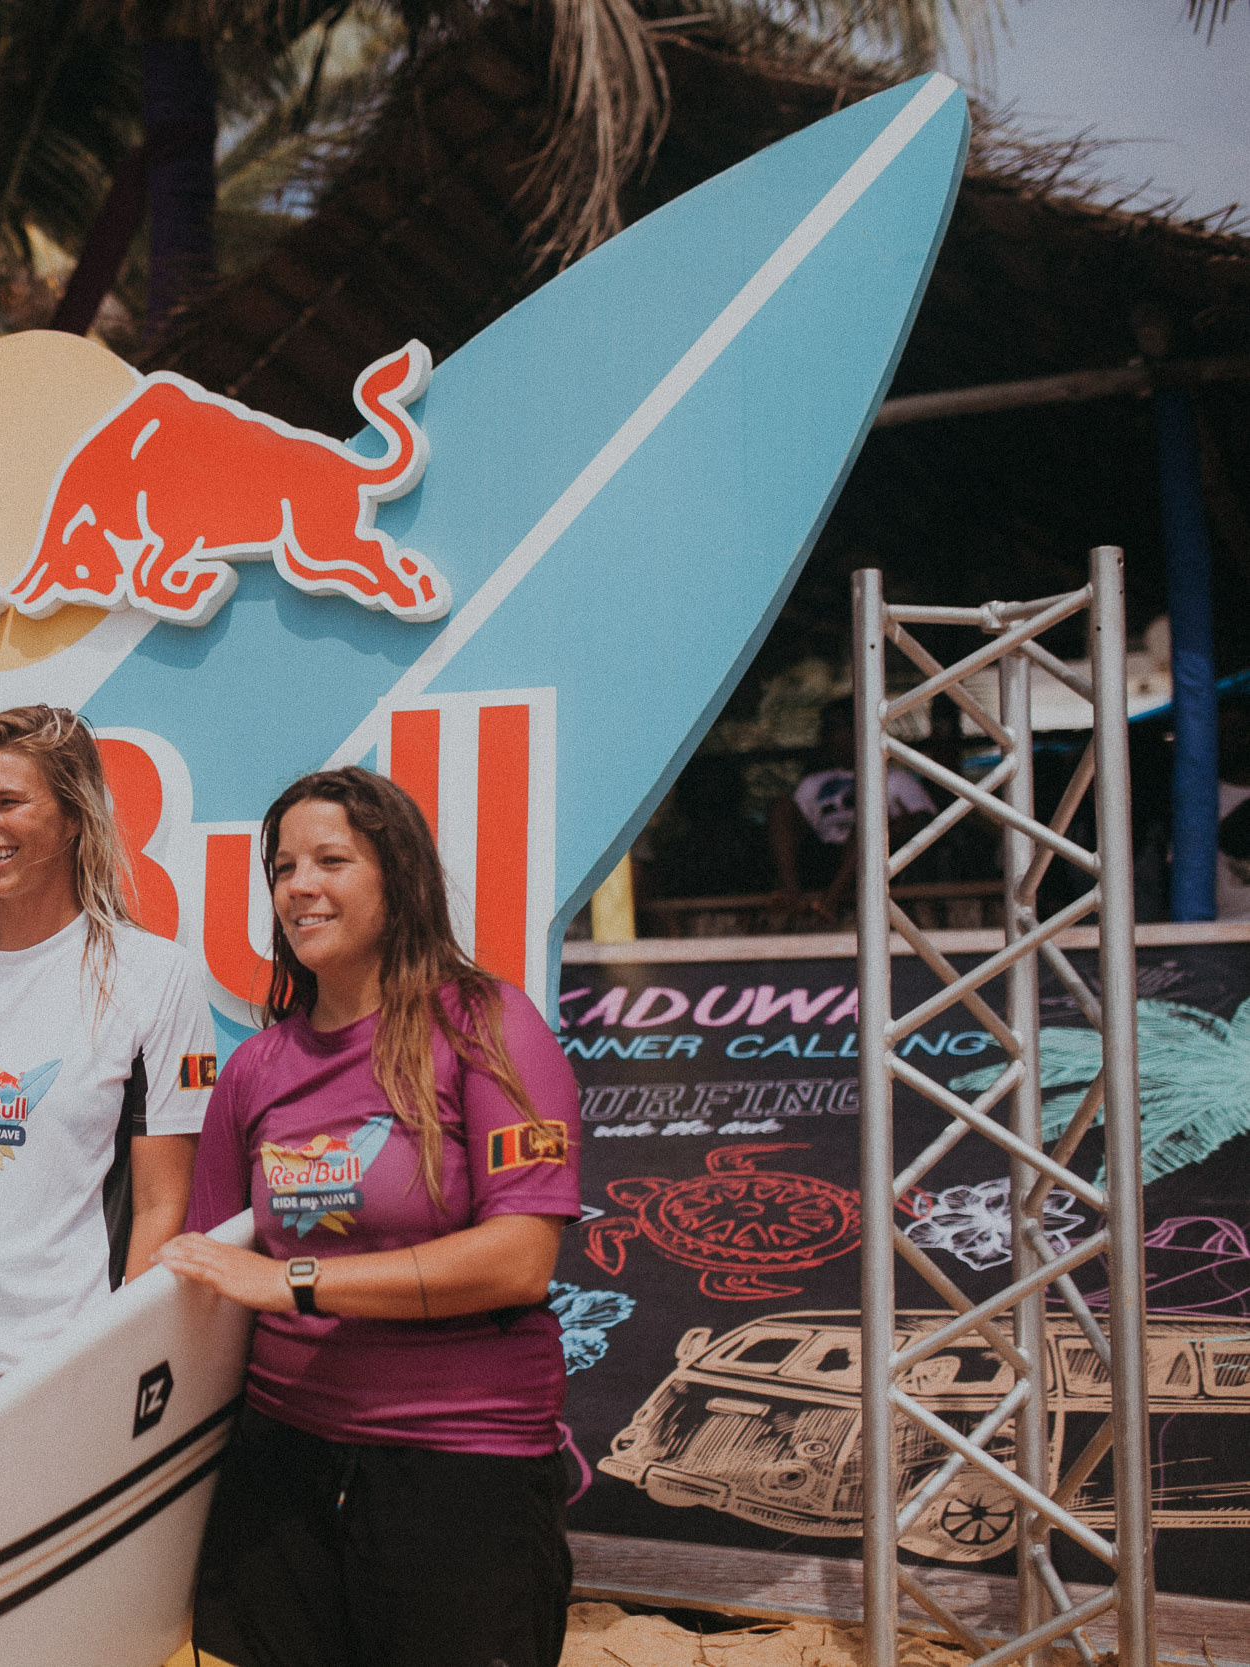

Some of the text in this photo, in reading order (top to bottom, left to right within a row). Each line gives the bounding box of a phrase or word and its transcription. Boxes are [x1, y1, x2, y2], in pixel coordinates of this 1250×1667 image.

[725, 1031, 989, 1059] CALLNG
[579, 1077, 860, 1121] URFING
[269, 1156, 360, 1185] Red Bull
[272, 1196, 298, 1209] RIDE
[319, 1192, 356, 1206] WAVE
